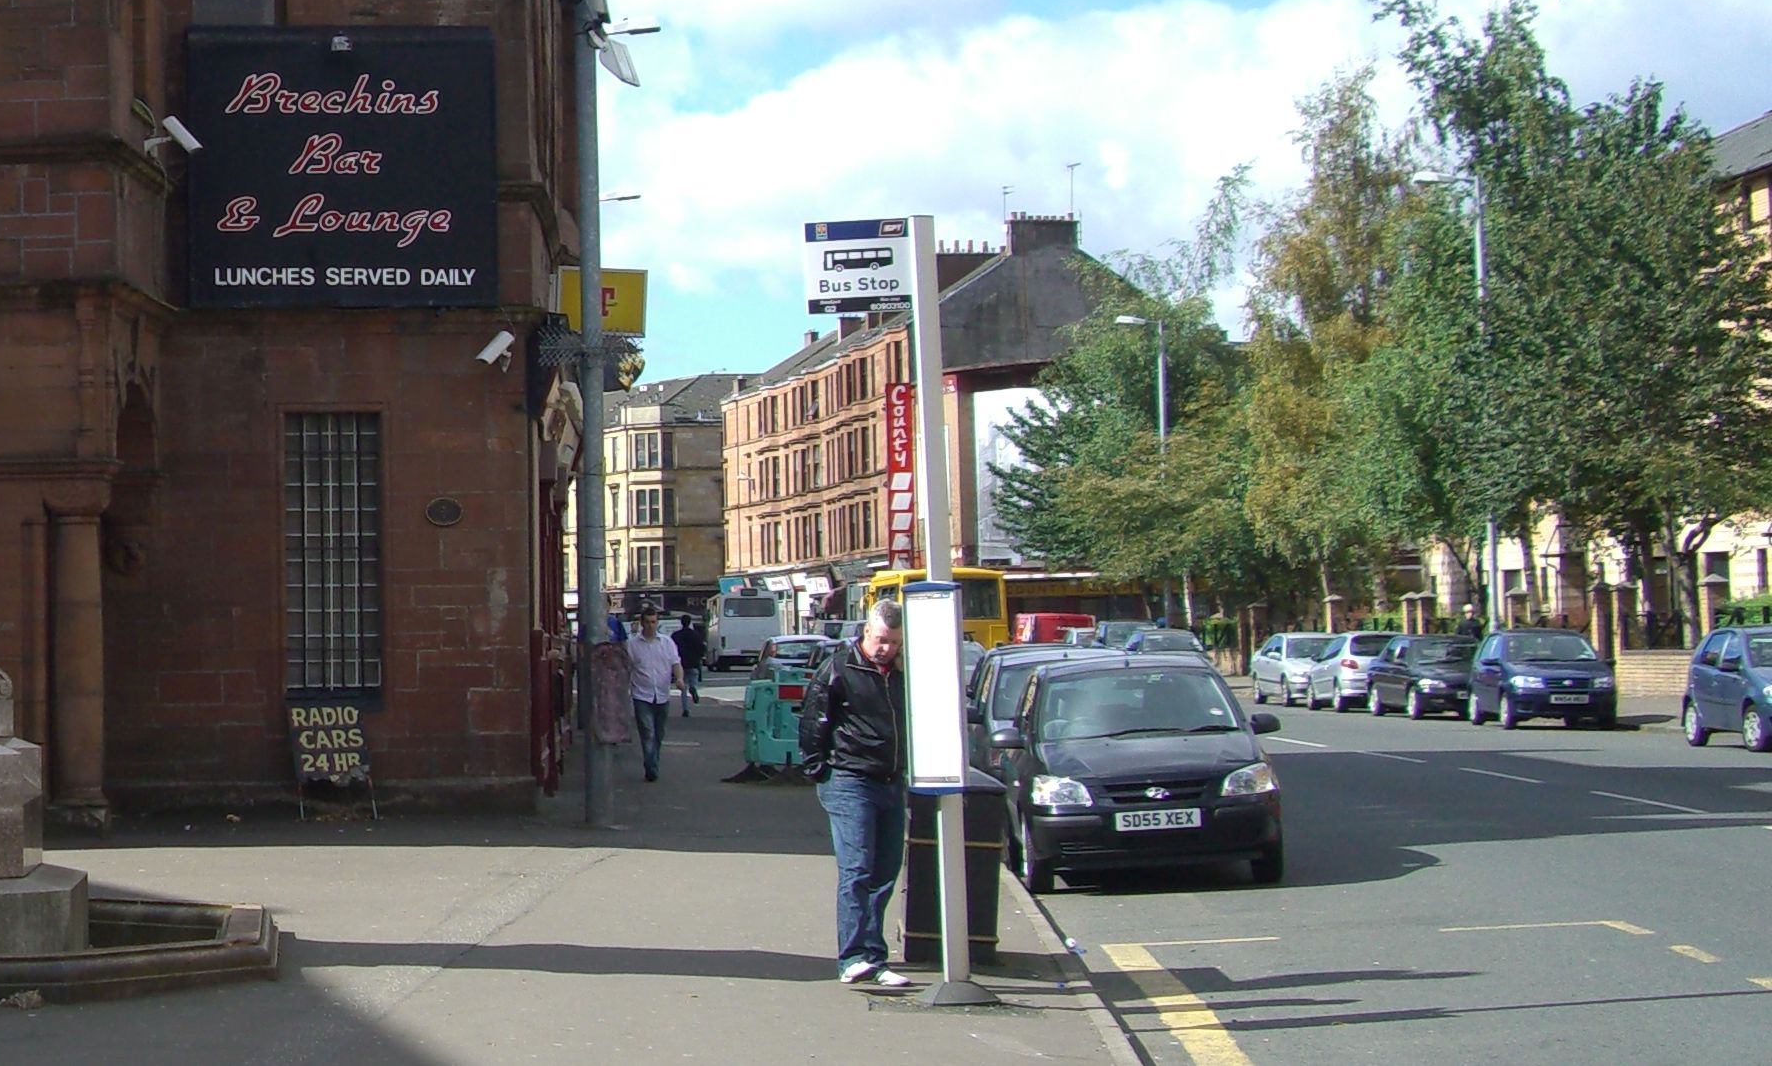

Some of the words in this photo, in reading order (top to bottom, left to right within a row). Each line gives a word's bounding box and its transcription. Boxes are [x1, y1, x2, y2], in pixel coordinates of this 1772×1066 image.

[225, 72, 439, 114] Brechins
[288, 133, 382, 175] Bar
[217, 196, 260, 231] &
[273, 193, 452, 248] Lounge
[214, 267, 315, 286] LUNCHES
[325, 267, 410, 286] SERVED
[420, 267, 476, 286] DAILY
[819, 279, 852, 293] Bus
[858, 276, 899, 291] Stop
[891, 385, 908, 468] County
[291, 706, 359, 726] RADIO
[299, 728, 364, 749] CARS
[301, 754, 329, 772] 24
[333, 752, 361, 771] HR
[1122, 814, 1161, 827] SD55
[1165, 811, 1194, 825] XEX
